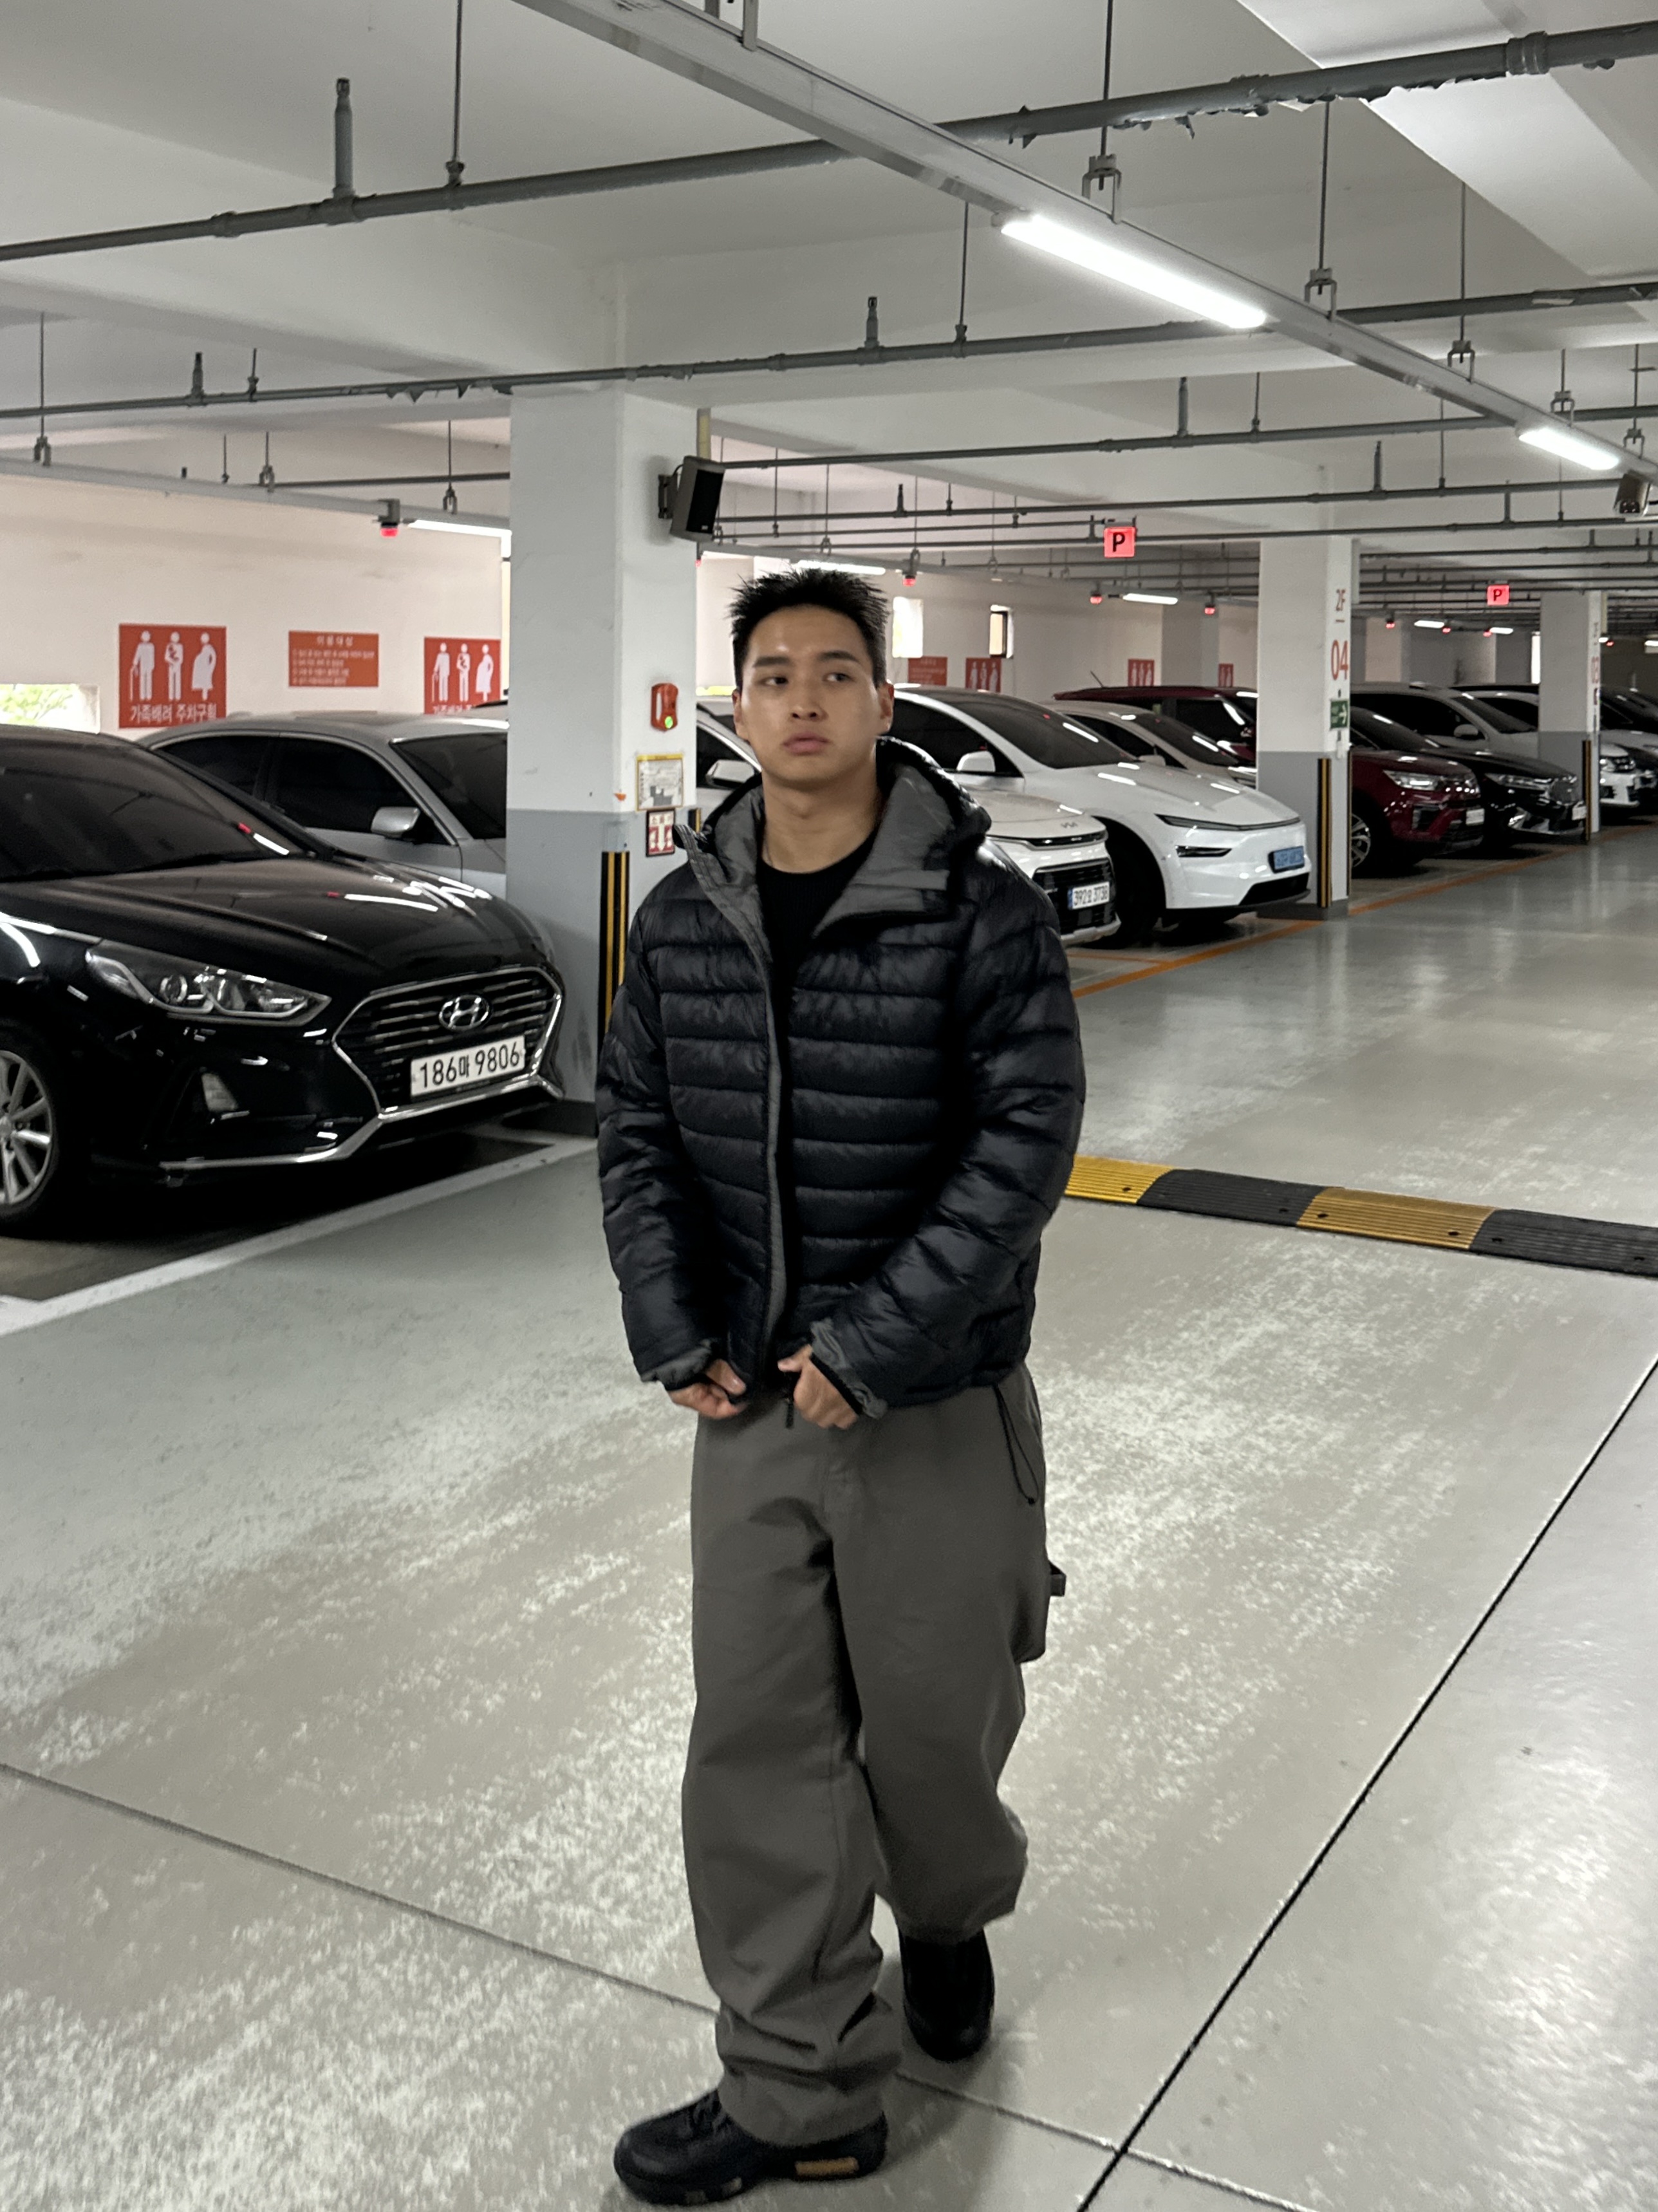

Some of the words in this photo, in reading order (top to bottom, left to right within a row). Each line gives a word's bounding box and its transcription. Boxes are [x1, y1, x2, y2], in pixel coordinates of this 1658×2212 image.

[1113, 532, 1125, 552] P
[1493, 588, 1502, 601] P
[1331, 639, 1348, 680] 04
[420, 1054, 470, 1089] 186마
[474, 1041, 520, 1076] 9806
